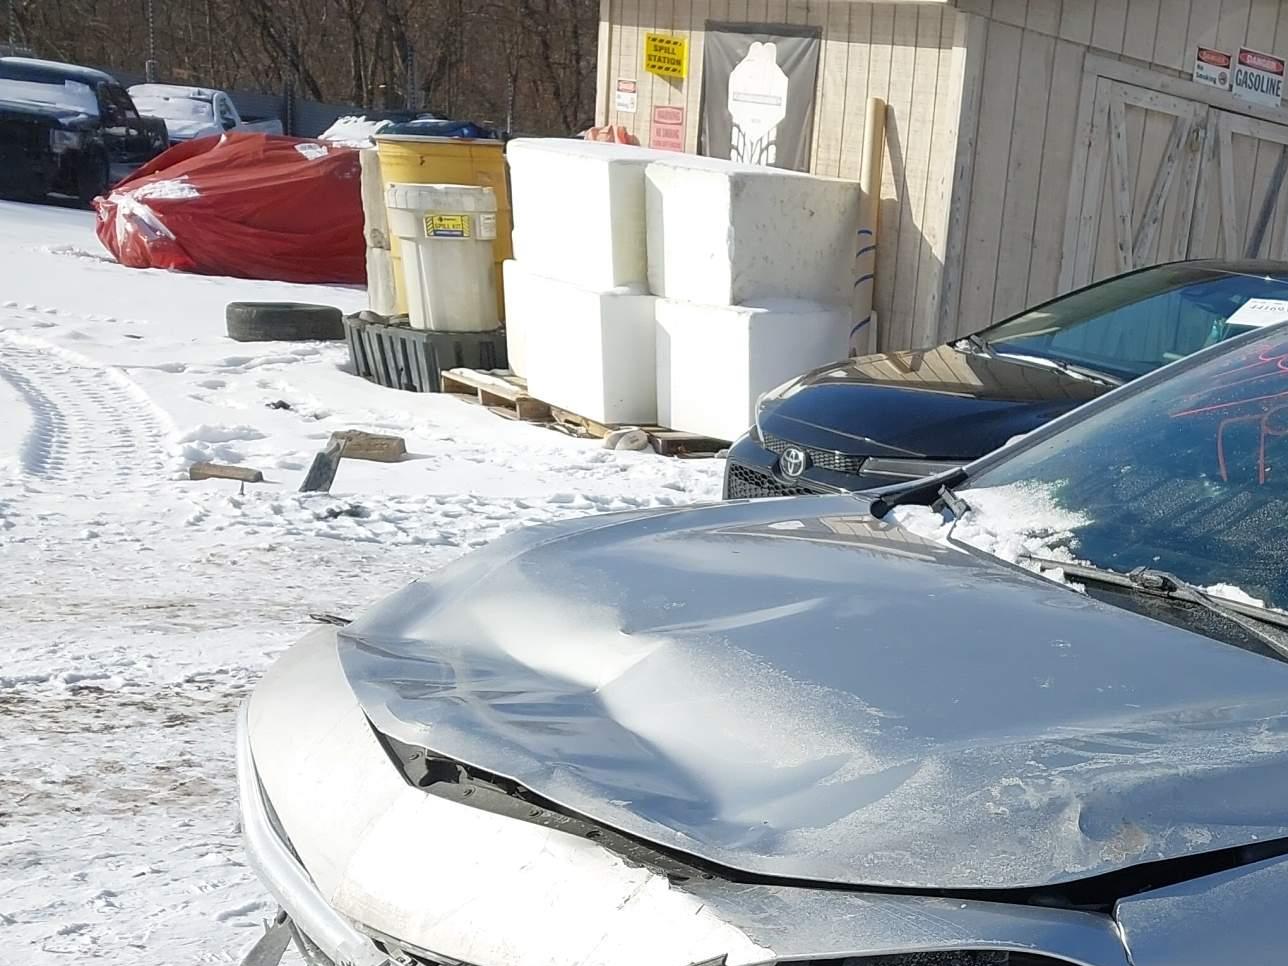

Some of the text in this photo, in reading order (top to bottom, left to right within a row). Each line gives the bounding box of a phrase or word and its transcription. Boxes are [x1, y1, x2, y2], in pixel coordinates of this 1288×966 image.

[654, 44, 676, 55] SPILL
[648, 54, 681, 66] STATION
[1235, 69, 1282, 97] GASOLINE
